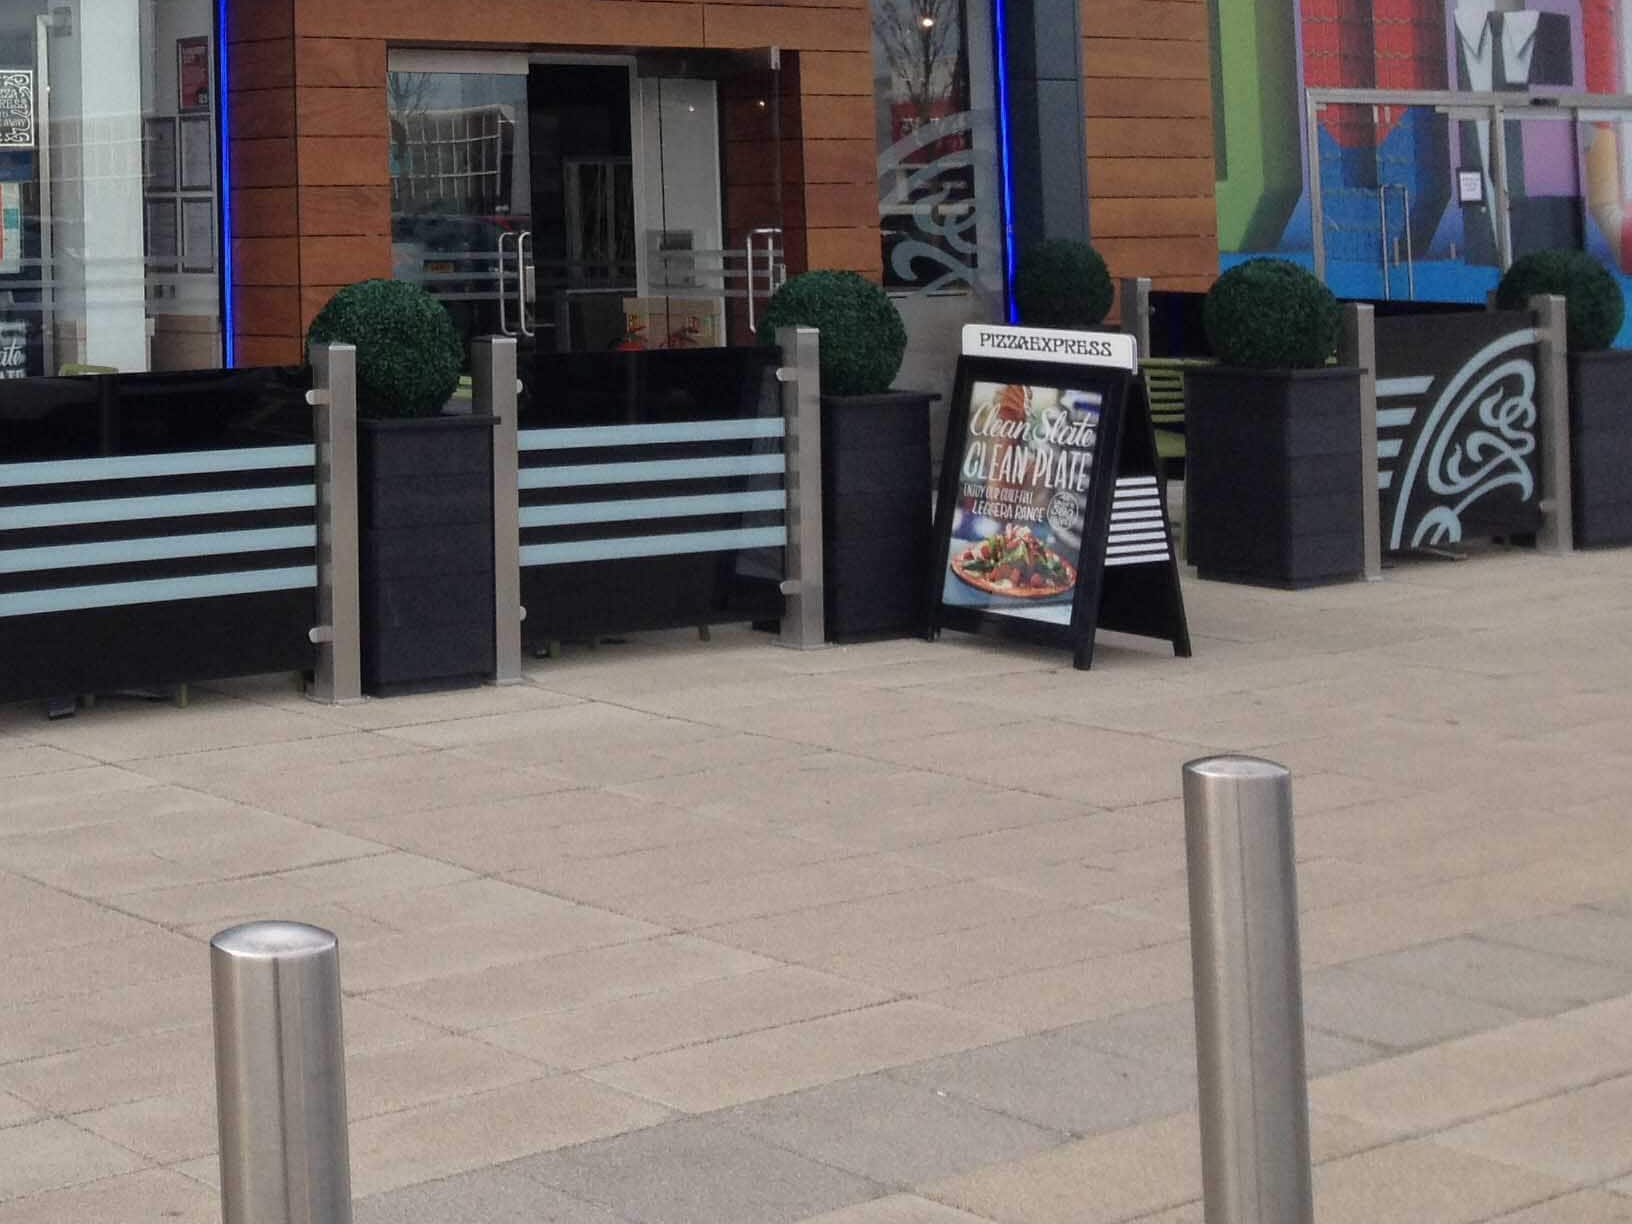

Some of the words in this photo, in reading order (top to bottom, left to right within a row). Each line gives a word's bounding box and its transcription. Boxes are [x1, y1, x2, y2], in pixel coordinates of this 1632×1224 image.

[979, 332, 1113, 357] PIZZAEXPRESS
[970, 403, 1030, 441] Clean
[1032, 407, 1096, 447] Slate
[963, 441, 1028, 485] CLEAN
[1031, 445, 1093, 492] PLATE
